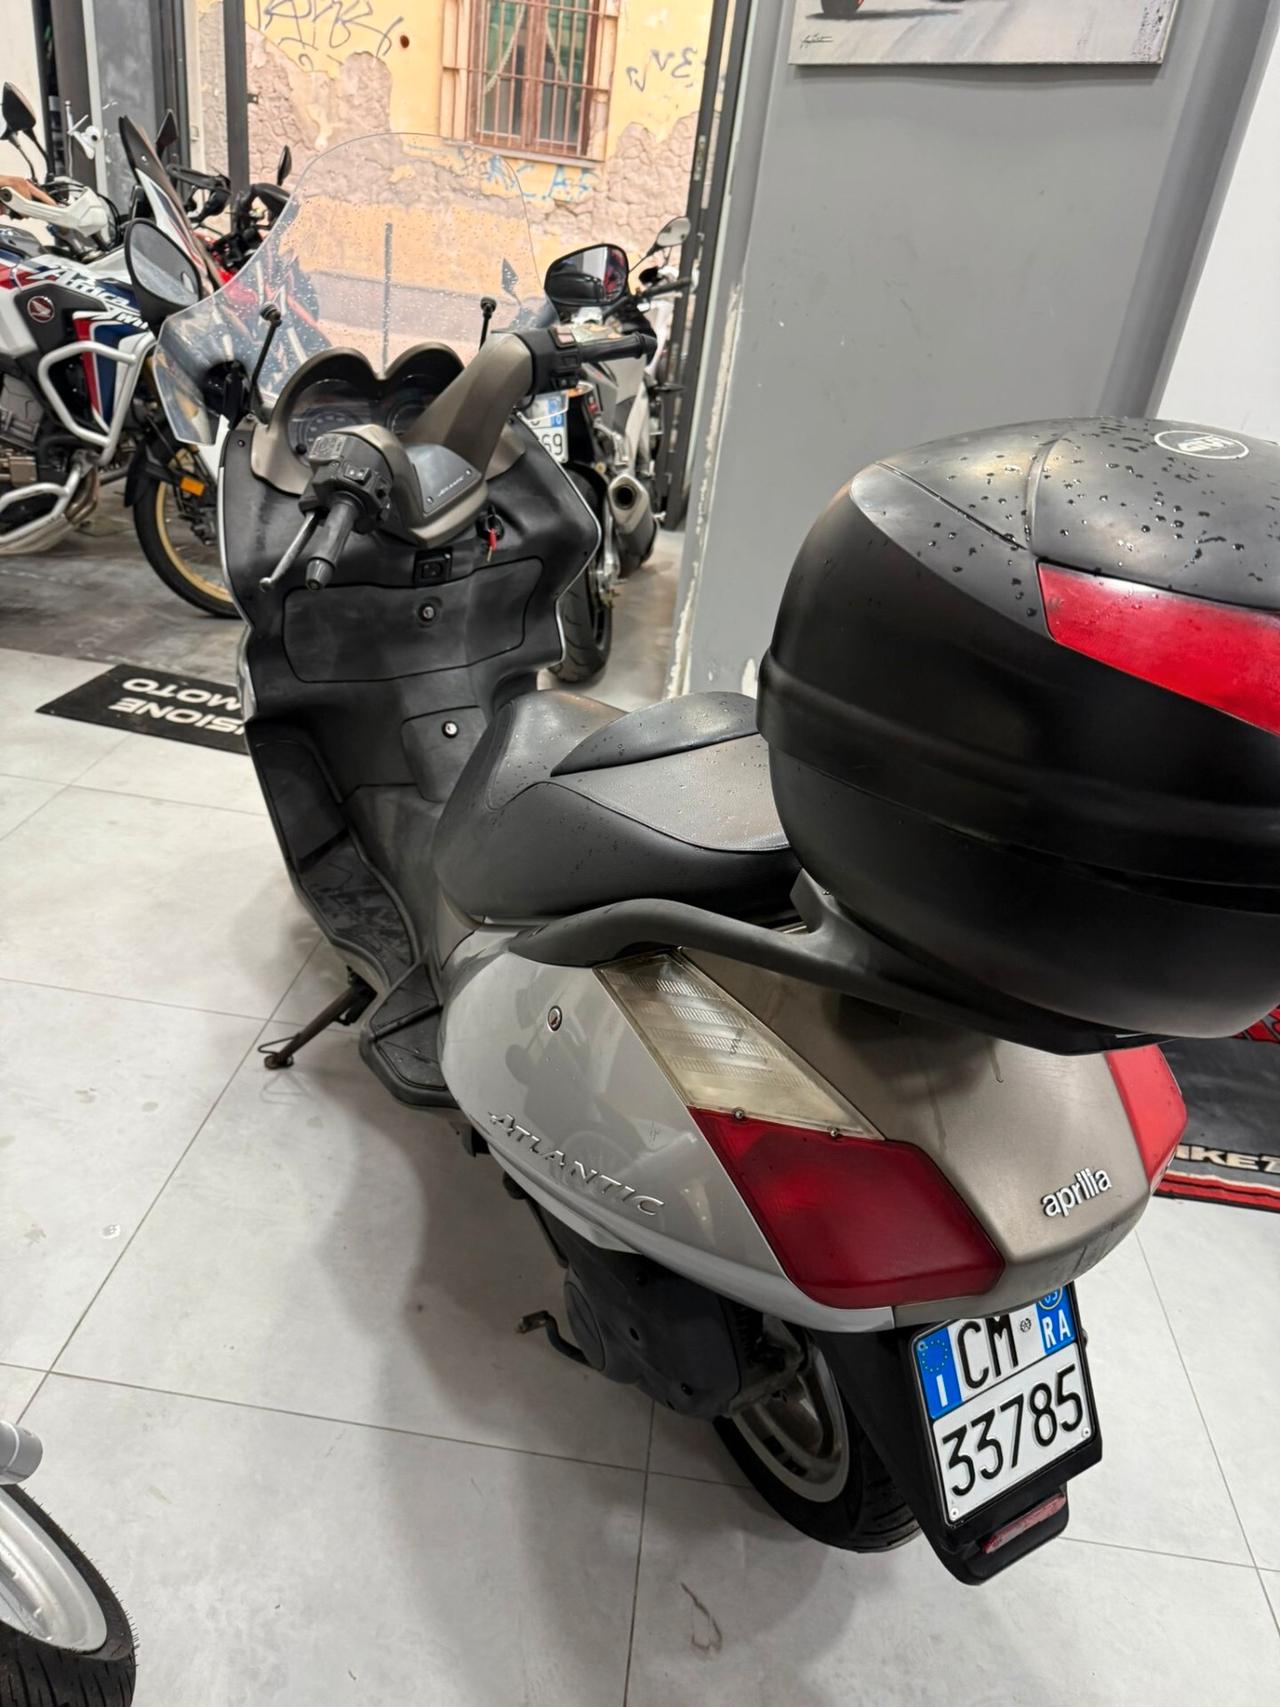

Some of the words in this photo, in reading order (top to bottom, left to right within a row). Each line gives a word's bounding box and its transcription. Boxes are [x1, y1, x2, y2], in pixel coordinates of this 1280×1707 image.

[122, 678, 242, 711] MOTO
[488, 1112, 664, 1216] ATLANTIC
[1042, 1168, 1112, 1217] aprilia
[957, 1313, 1019, 1389] CM
[1042, 1309, 1071, 1349] RA
[942, 1364, 1083, 1496] 33785
